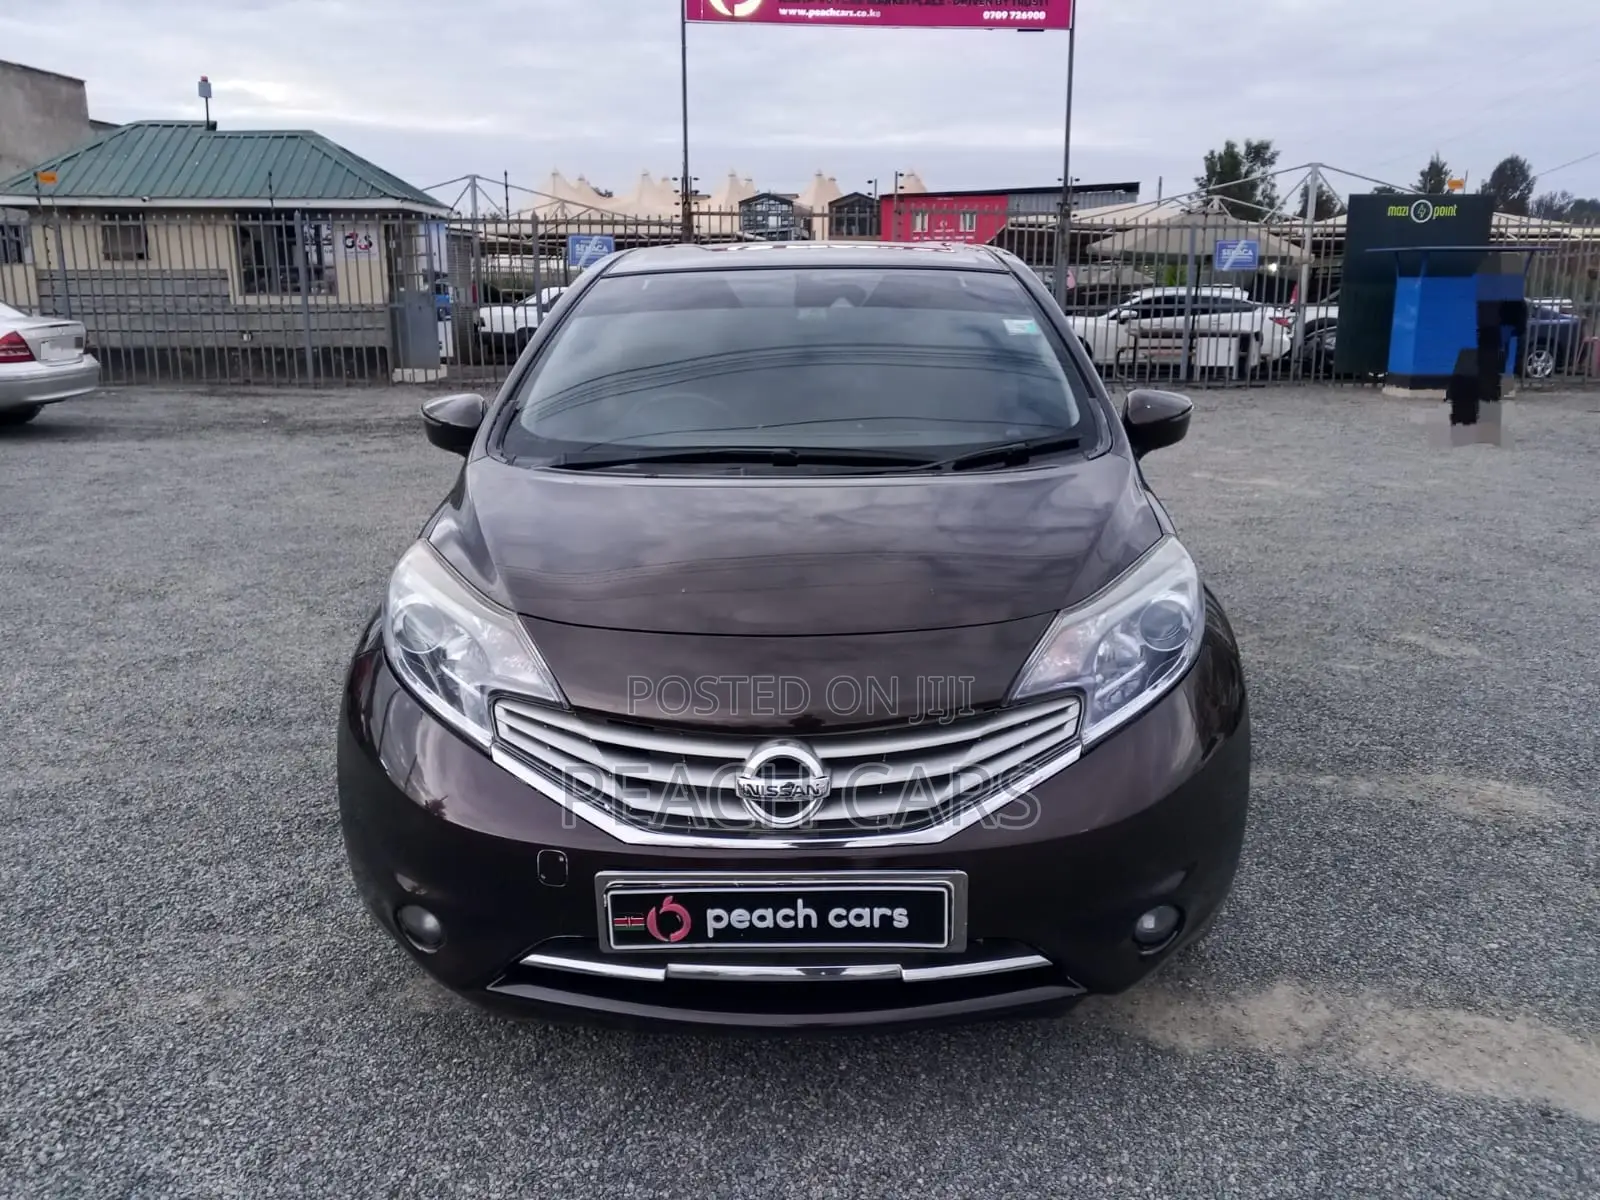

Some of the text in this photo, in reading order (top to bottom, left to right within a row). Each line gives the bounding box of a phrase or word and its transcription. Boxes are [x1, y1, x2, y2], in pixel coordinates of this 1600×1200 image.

[982, 10, 1008, 20] 0709
[1432, 204, 1458, 220] point
[742, 783, 820, 797] NISSAN
[707, 899, 909, 938] peach cars
